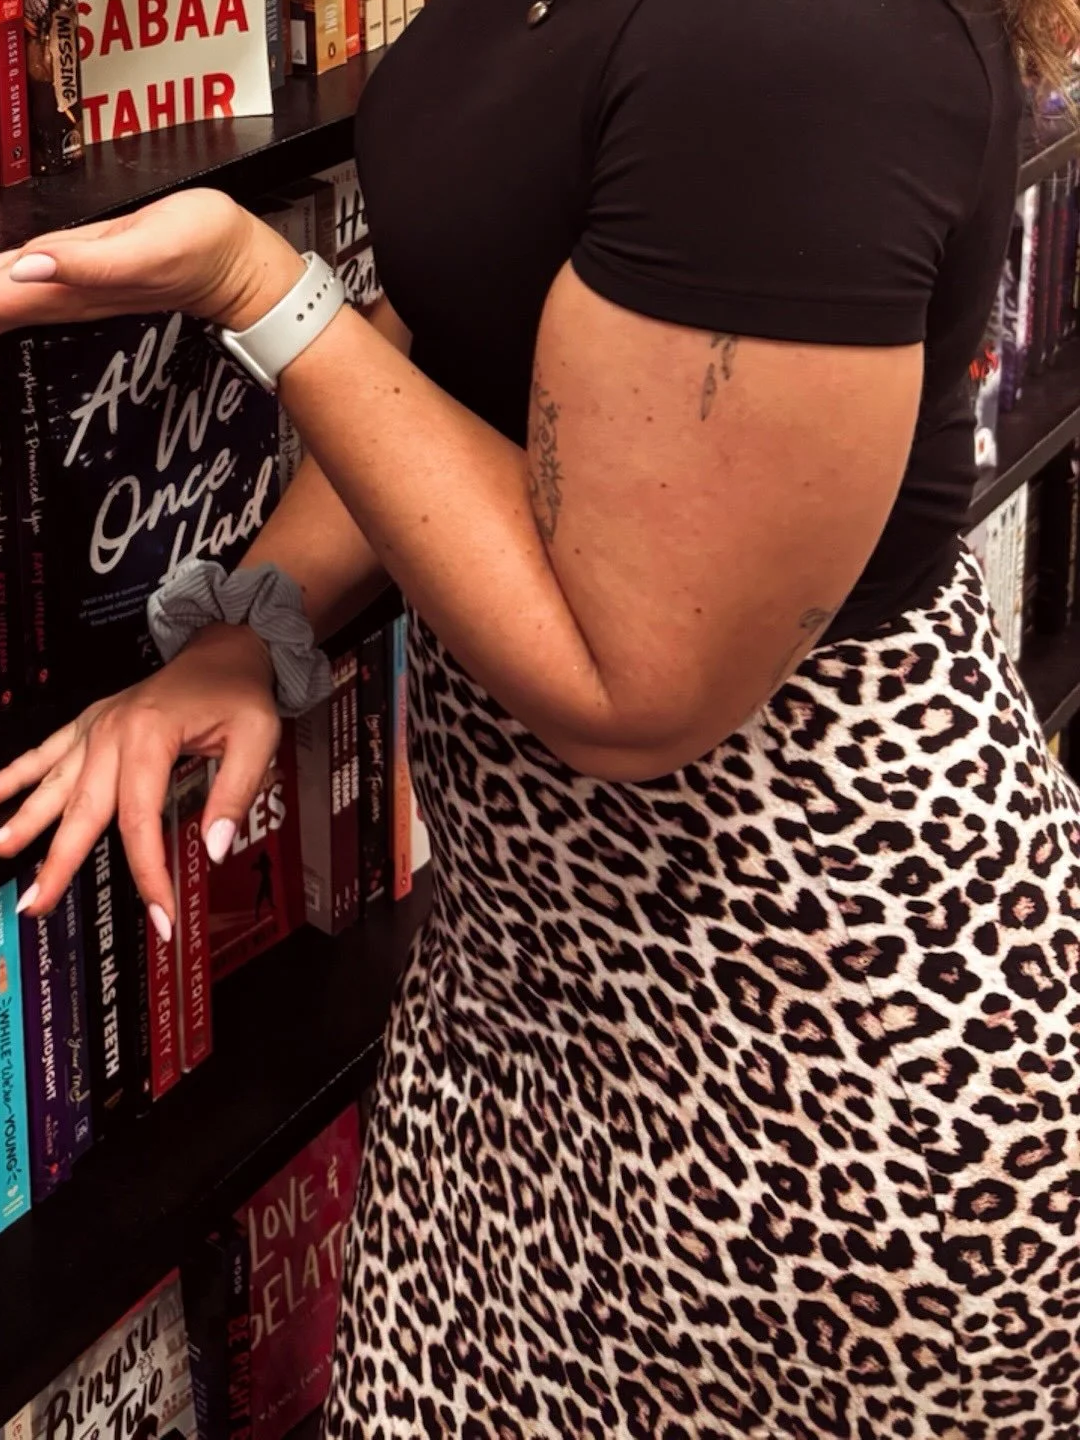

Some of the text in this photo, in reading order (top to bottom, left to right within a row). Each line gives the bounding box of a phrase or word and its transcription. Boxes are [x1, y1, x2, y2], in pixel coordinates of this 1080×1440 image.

[83, 71, 237, 145] TAHIR
[64, 311, 183, 468] All
[156, 358, 248, 472] We
[89, 447, 237, 575] Once
[158, 456, 273, 585] Had
[92, 835, 121, 1080] THE RIVER HAS TEETH
[185, 822, 205, 1031] CODE NAME VERITY
[249, 1175, 318, 1273] LOVE
[45, 1306, 159, 1440] Bingsu
